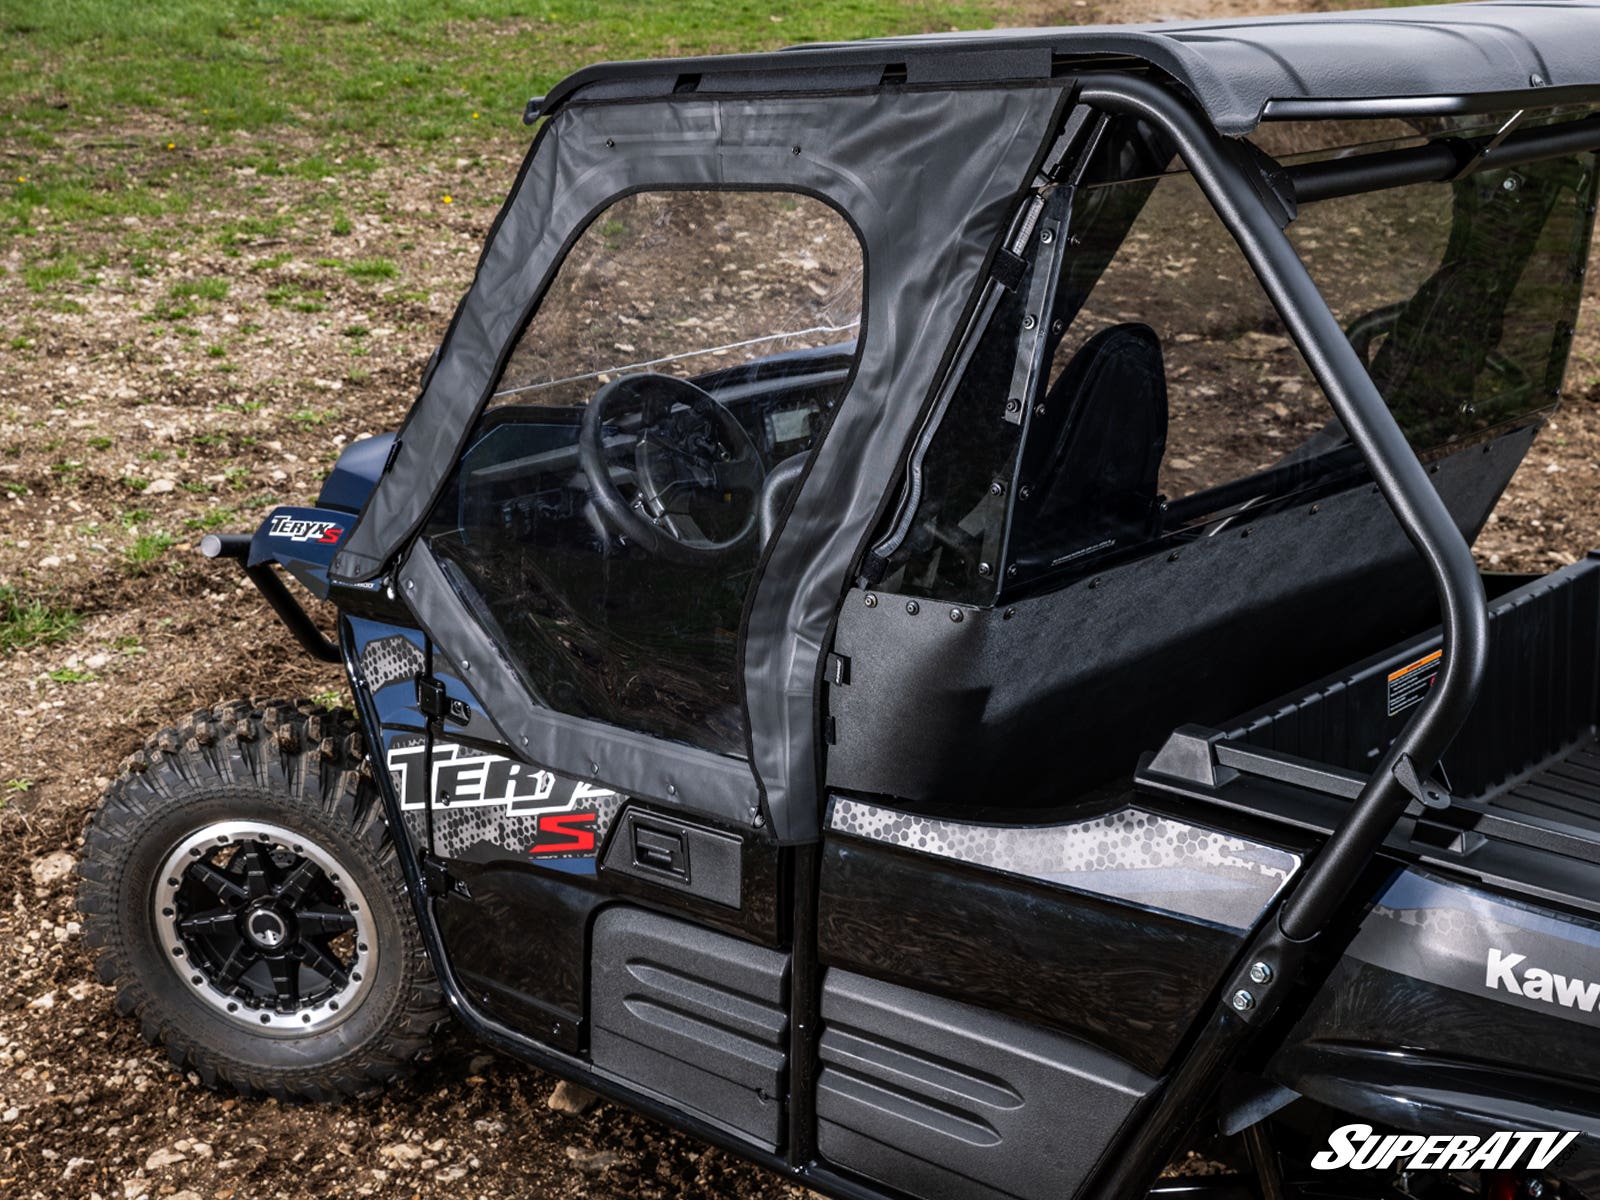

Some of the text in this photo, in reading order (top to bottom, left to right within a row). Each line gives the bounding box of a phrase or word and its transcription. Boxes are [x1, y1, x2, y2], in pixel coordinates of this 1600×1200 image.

[387, 744, 615, 816] TERY
[528, 813, 596, 853] S
[1485, 948, 1600, 1012] Kaw
